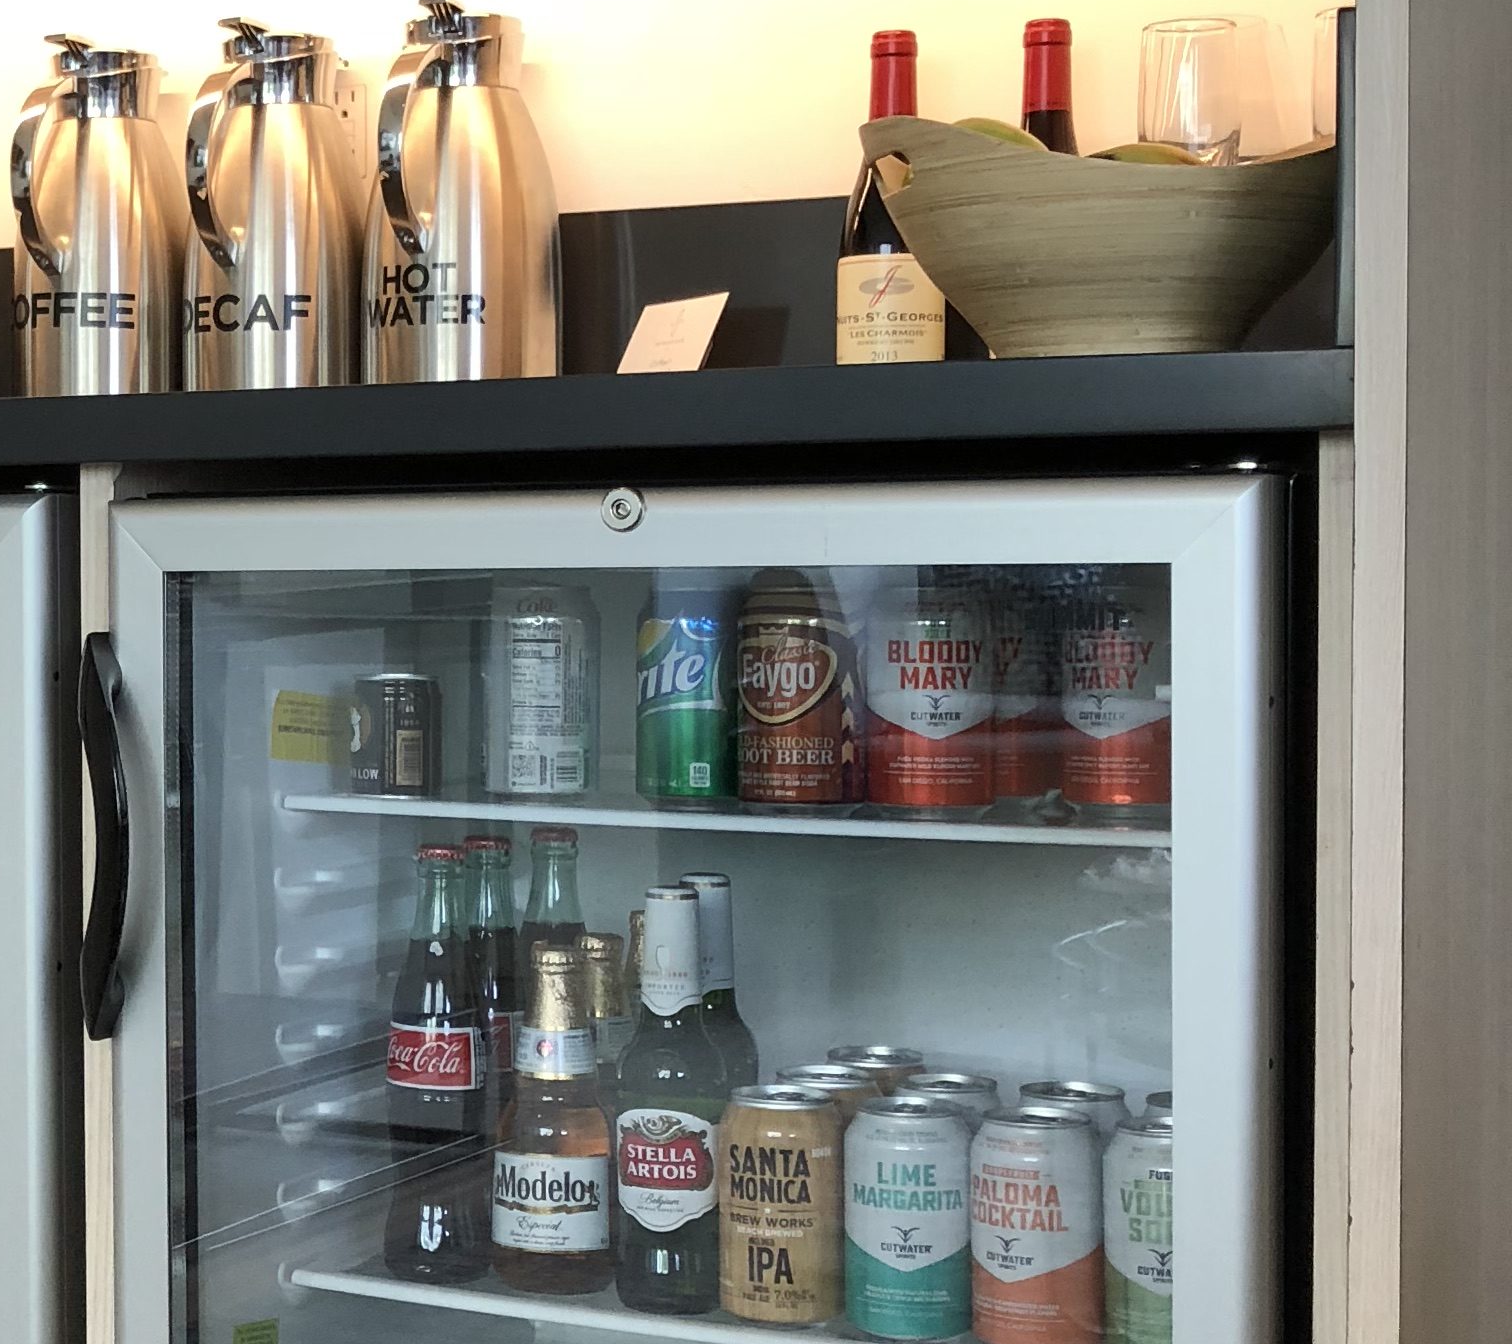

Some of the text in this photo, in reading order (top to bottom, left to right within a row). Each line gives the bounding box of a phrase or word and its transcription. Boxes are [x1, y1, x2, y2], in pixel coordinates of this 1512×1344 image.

[383, 262, 457, 295] HOT
[368, 293, 486, 327] WATER
[872, 350, 898, 362] 2013
[888, 639, 983, 664] BLOODY
[742, 654, 816, 698] Faygo
[900, 666, 973, 690] MARY
[1072, 667, 1139, 690] MARY
[910, 711, 962, 721] CUTWATER
[775, 750, 835, 765] BEER
[627, 1144, 696, 1163] STELLA
[729, 1143, 811, 1178] SANTA
[499, 1163, 586, 1203] Modelo
[627, 1163, 697, 1180] ARTOIS
[876, 1161, 937, 1187] LIME
[1148, 1169, 1173, 1181] FUG
[730, 1173, 812, 1204] MONICA
[853, 1182, 964, 1212] MARGARITA
[972, 1173, 1061, 1208] PALOMA
[730, 1211, 814, 1229] BREW WORKS
[972, 1197, 1069, 1233] COCKTAIL
[880, 1242, 934, 1254] CUTWATER
[986, 1251, 1034, 1266] CUTWATER
[747, 1245, 795, 1285] IPA
